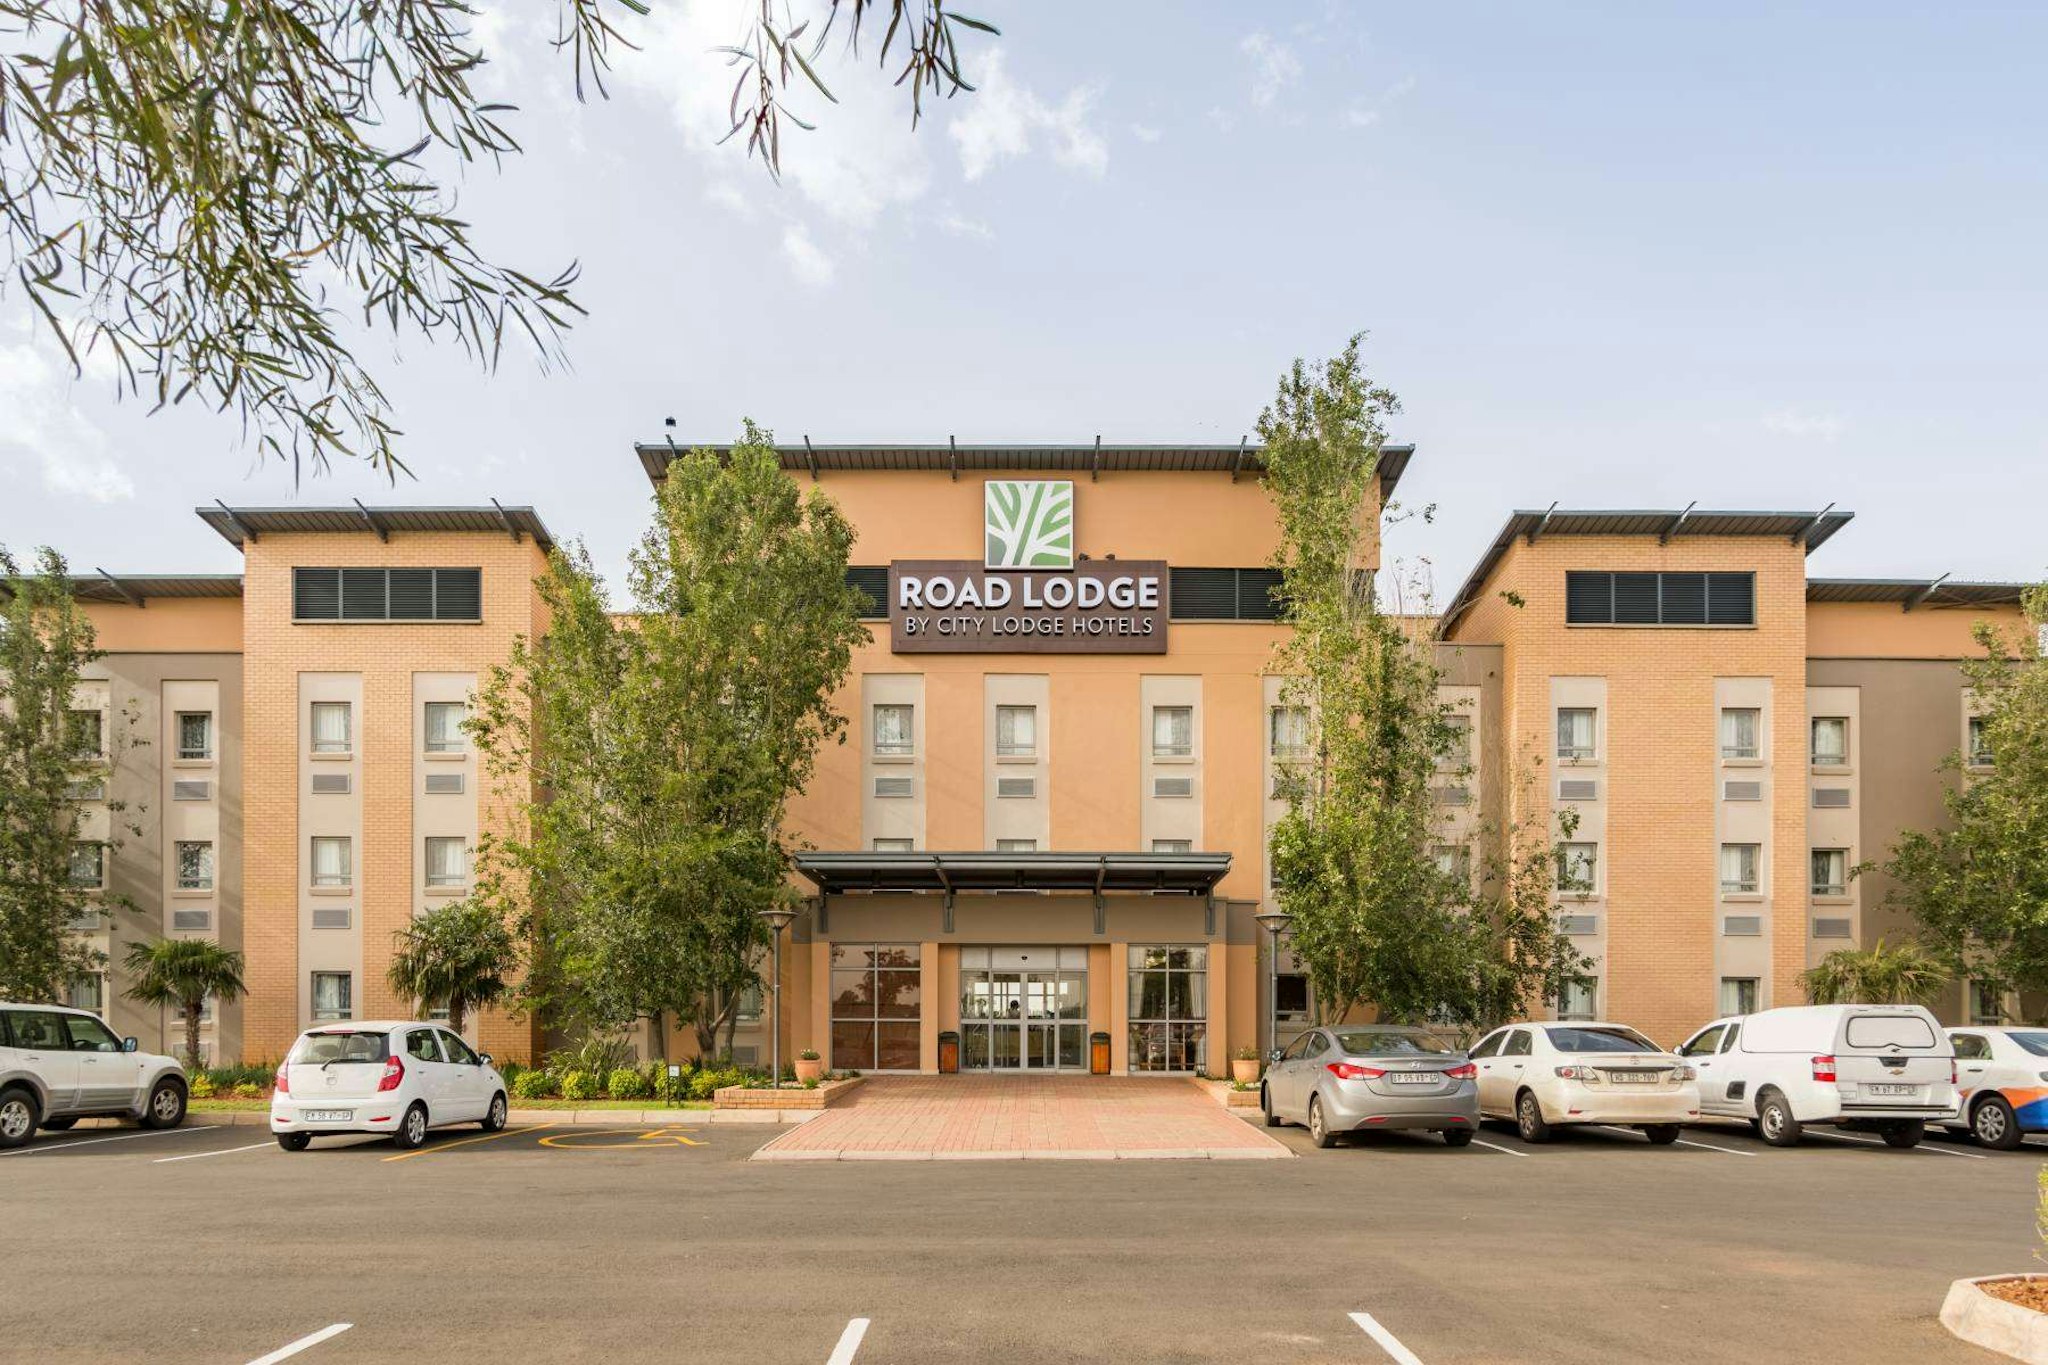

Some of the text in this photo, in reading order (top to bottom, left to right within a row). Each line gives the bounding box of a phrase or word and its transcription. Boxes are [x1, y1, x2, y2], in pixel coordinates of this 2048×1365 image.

[899, 576, 1159, 608] ROAD LODGE
[905, 616, 1153, 635] BY CITY LODGE HOTELS
